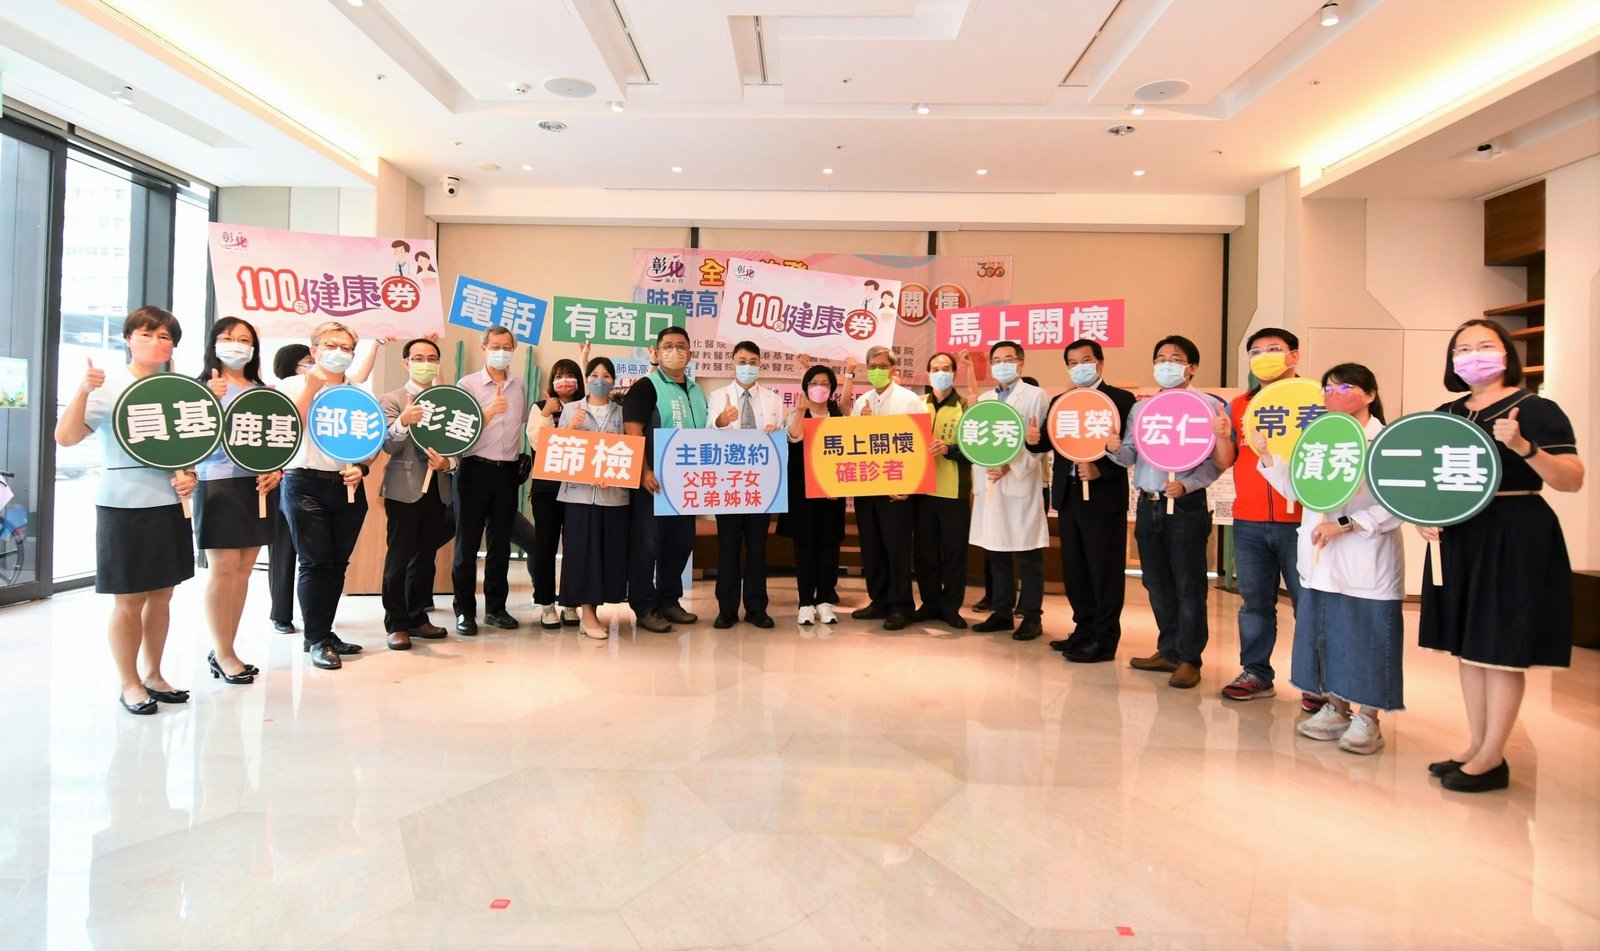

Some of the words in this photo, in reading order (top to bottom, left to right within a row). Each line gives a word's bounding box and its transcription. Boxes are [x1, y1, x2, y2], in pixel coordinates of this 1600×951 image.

[652, 255, 686, 278] 彰化
[237, 265, 420, 317] 100元健康券
[647, 288, 725, 318] 肺癌高
[459, 283, 537, 339] 電話
[564, 303, 674, 342] 有窗口
[736, 291, 878, 340] 100元健康券
[947, 305, 1110, 348] 馬上關懷
[126, 399, 218, 444] 員基
[229, 411, 297, 448] 鹿基
[315, 405, 380, 441] 部彰
[416, 399, 479, 443] 彰基
[962, 418, 1020, 448] 彰秀
[1055, 409, 1113, 440] 員榮
[1141, 413, 1209, 446] 宏仁
[543, 434, 635, 481] 篩檢
[675, 443, 770, 467] 主動邀約
[823, 432, 915, 456] 馬上關懷
[1295, 441, 1361, 483] 濱秀
[835, 459, 905, 484] 確診者
[1377, 444, 1489, 492] 二基
[682, 490, 763, 509] 兄弟姊妹
